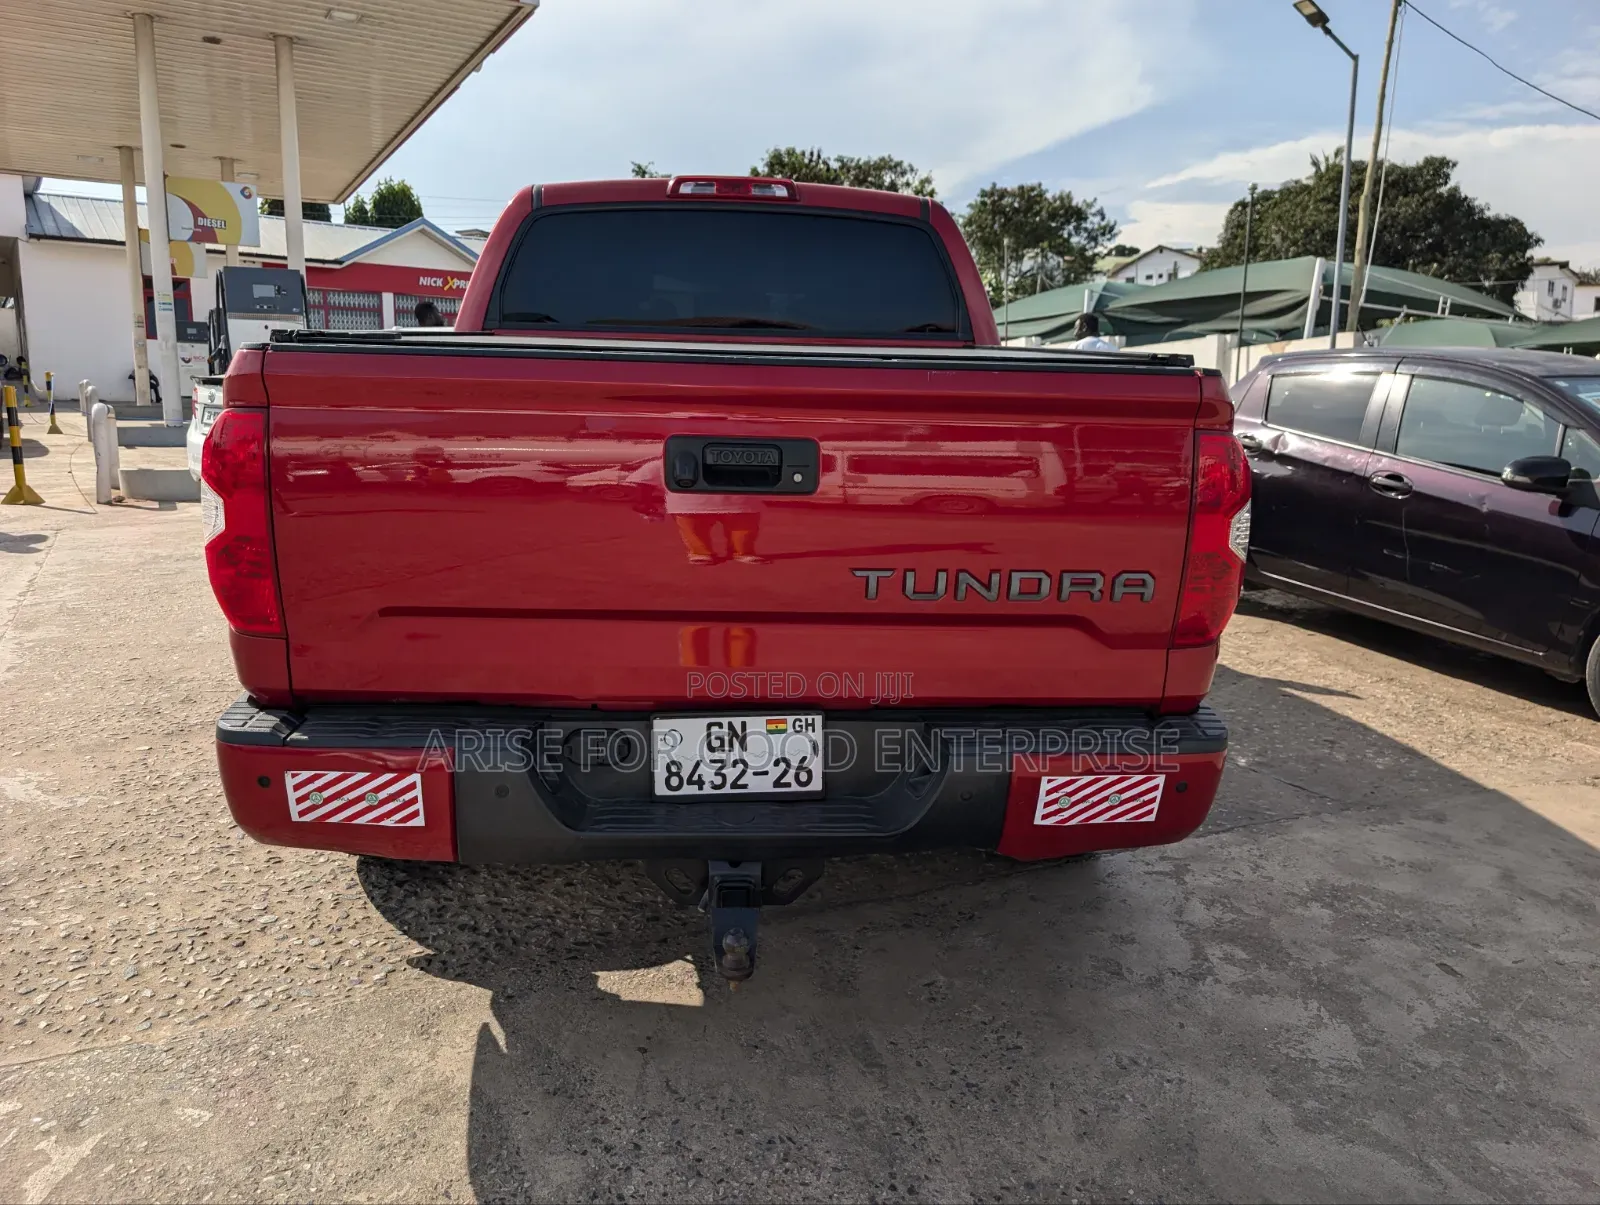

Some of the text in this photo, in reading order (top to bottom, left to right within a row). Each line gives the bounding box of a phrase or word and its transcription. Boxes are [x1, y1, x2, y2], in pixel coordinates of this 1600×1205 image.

[197, 217, 227, 230] DIESEL
[419, 276, 443, 287] NICK
[710, 449, 777, 464] TOYOTA
[849, 568, 1157, 603] TUNDRA
[706, 717, 816, 753] GN GH
[664, 755, 814, 792] 8432-26
